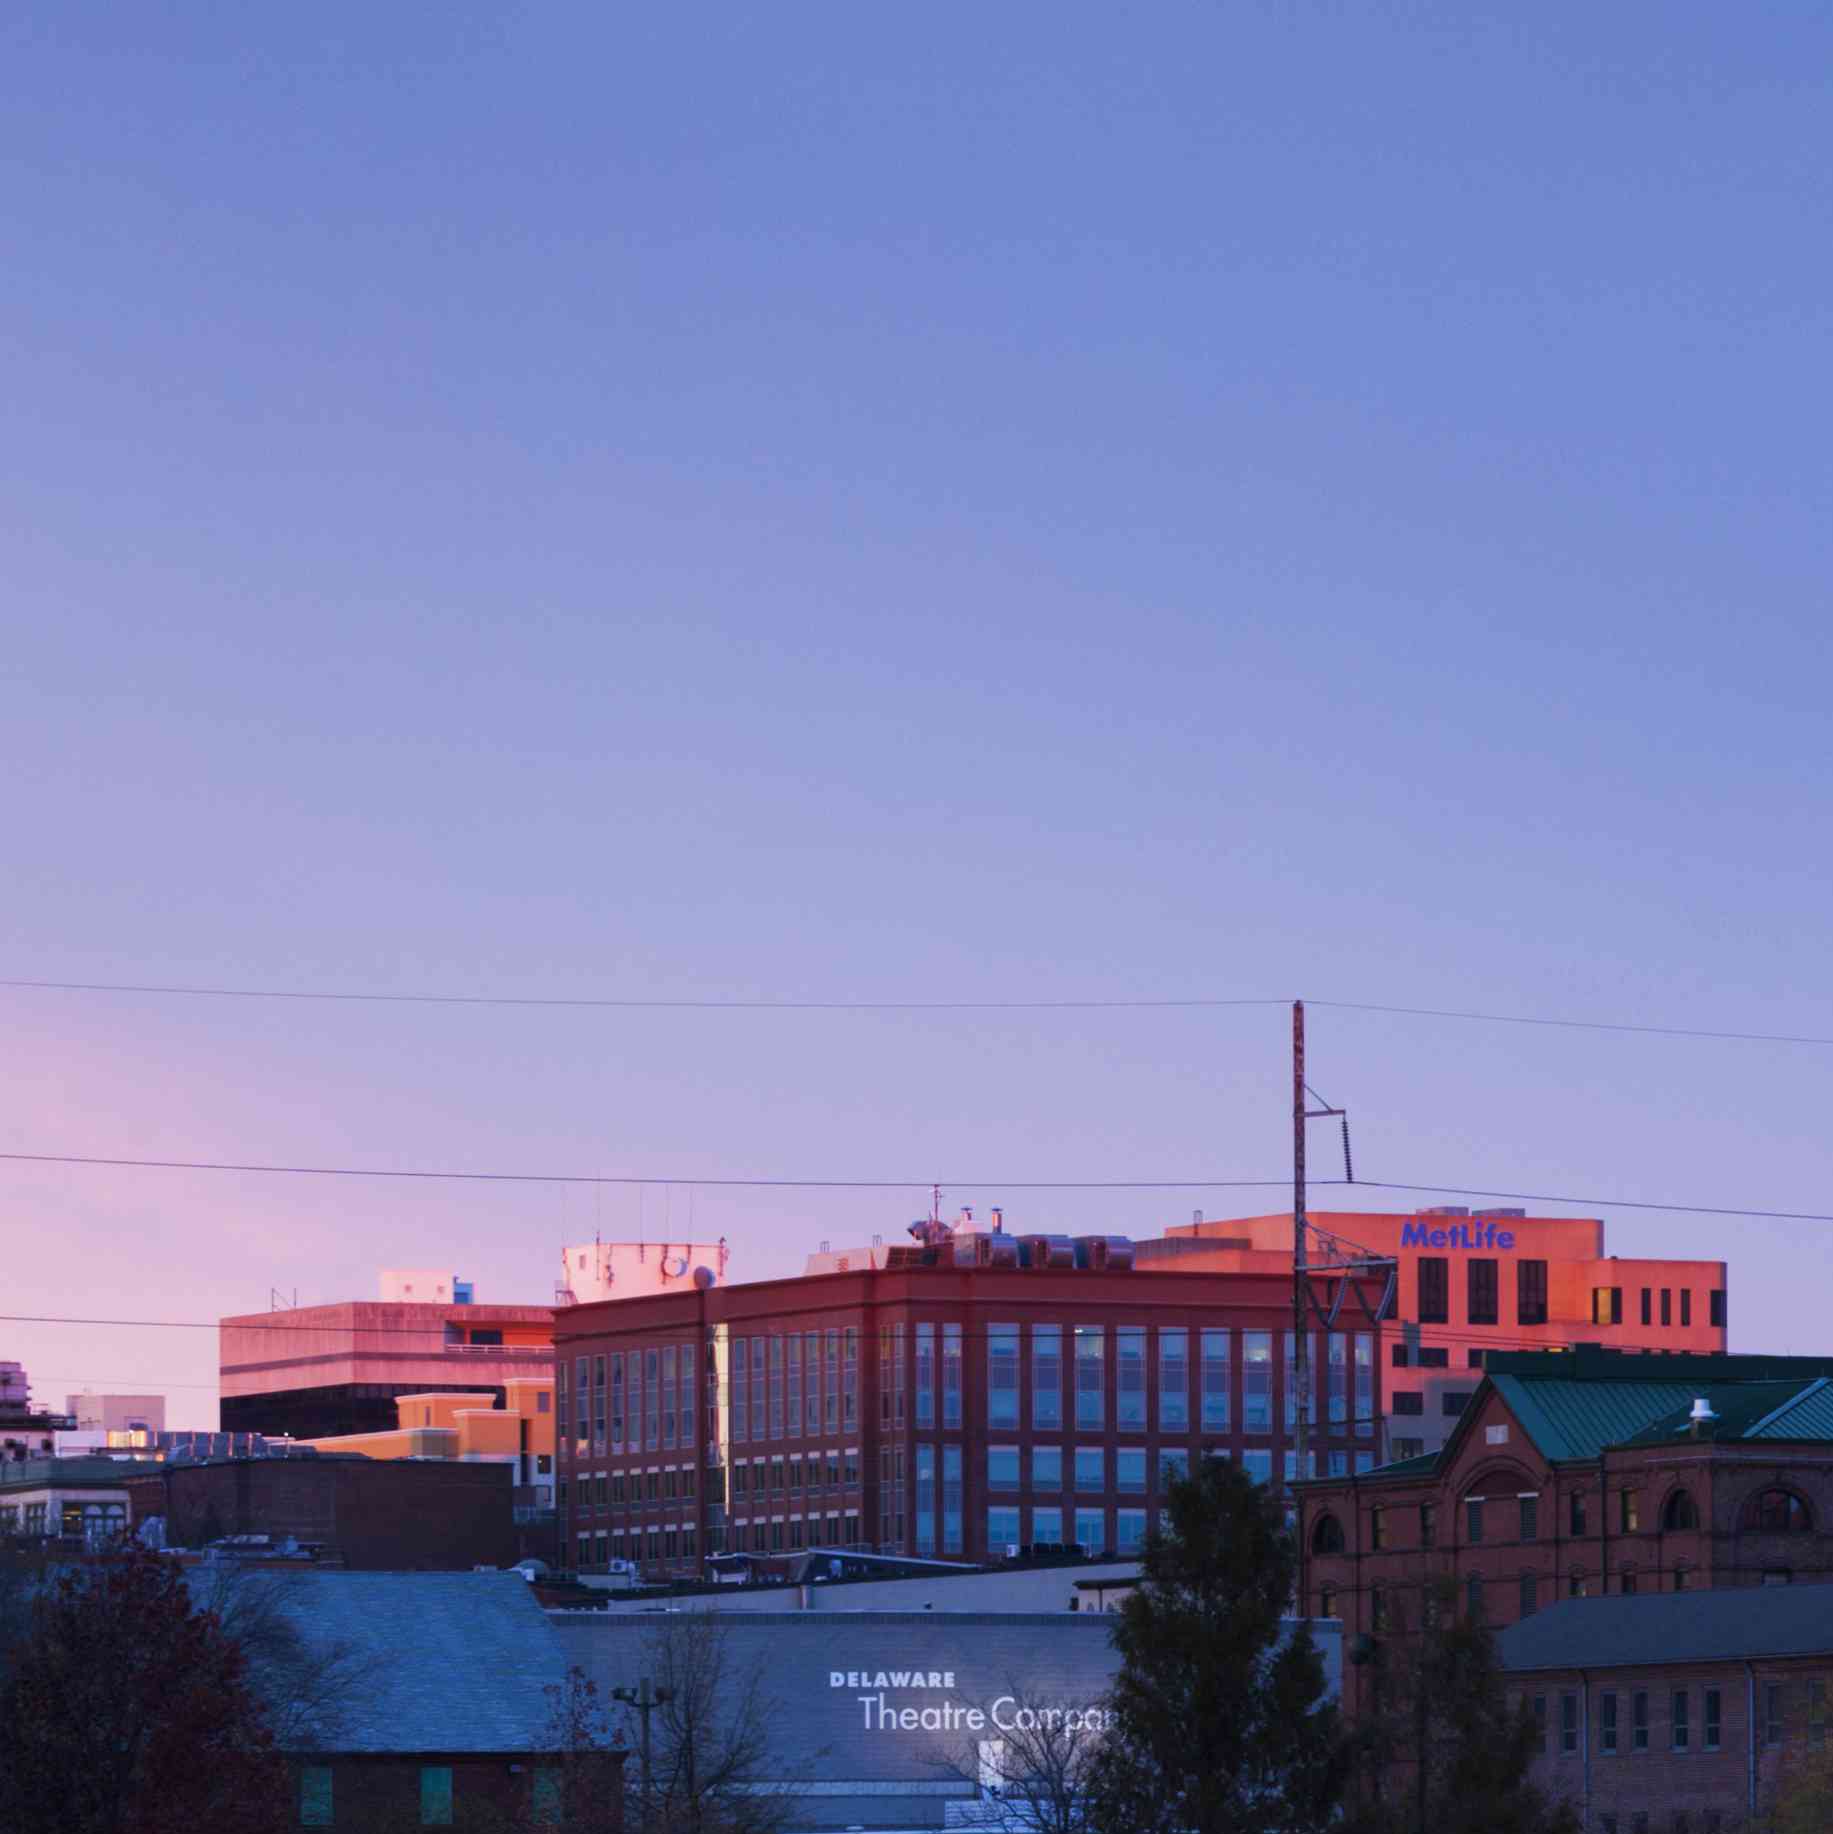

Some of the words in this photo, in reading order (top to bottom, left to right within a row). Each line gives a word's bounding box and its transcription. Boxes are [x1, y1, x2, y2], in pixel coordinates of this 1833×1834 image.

[1401, 1219, 1516, 1249] MetLife
[829, 1671, 956, 1688] DELAWARE
[857, 1692, 985, 1730] Theatre
[991, 1696, 1120, 1738] Compan
